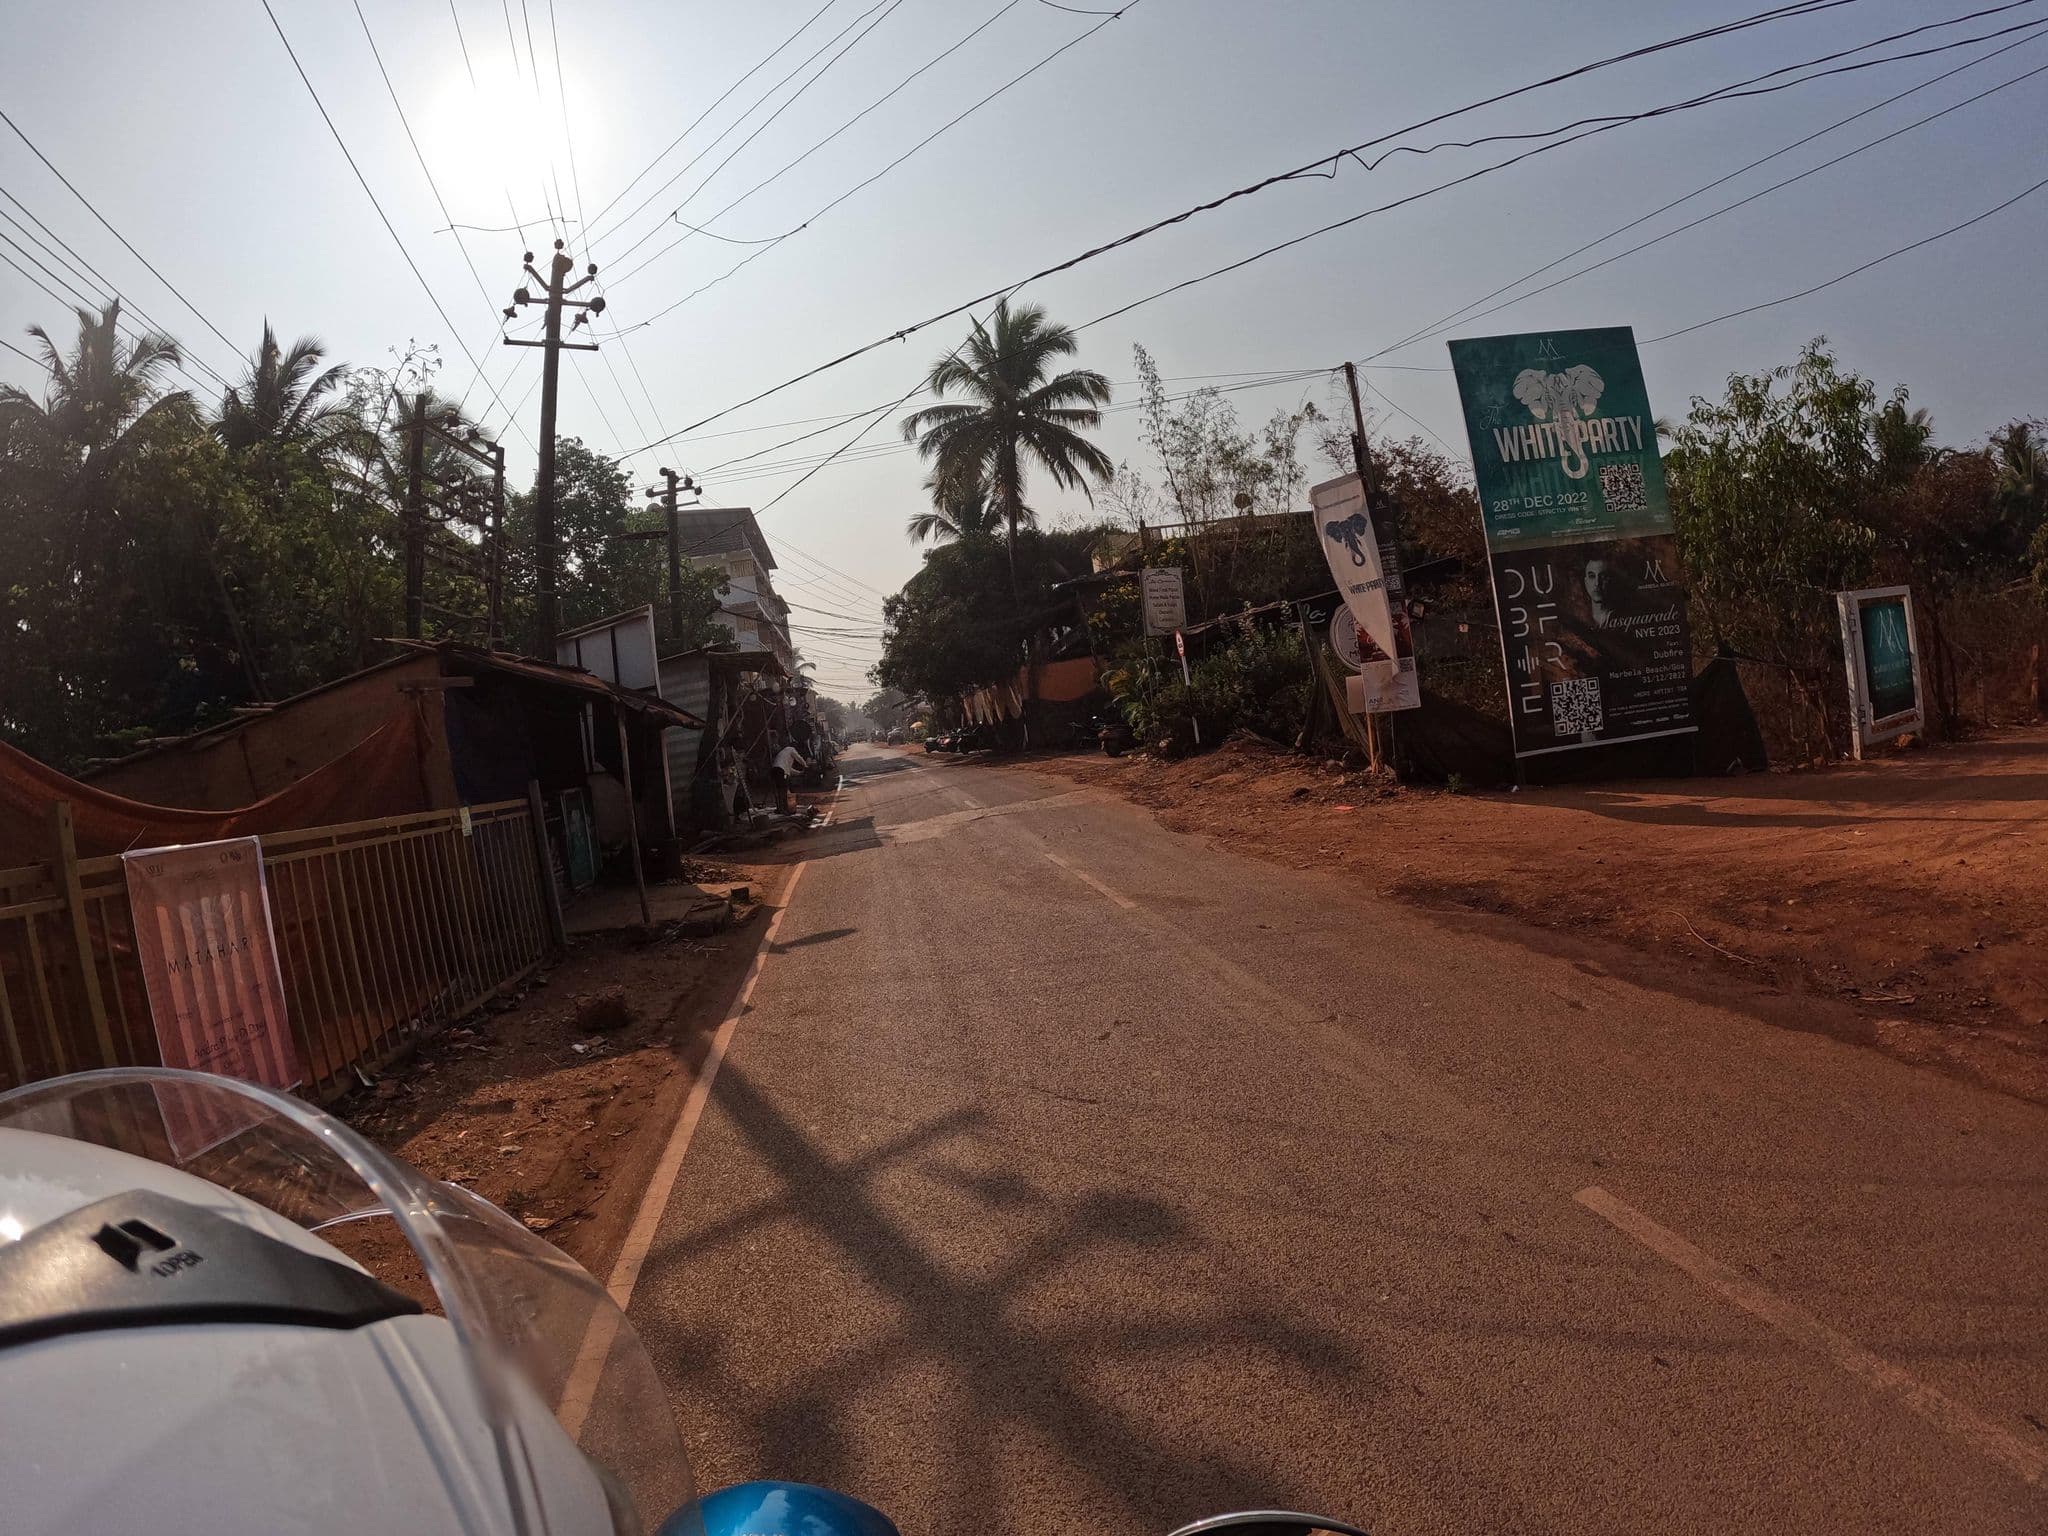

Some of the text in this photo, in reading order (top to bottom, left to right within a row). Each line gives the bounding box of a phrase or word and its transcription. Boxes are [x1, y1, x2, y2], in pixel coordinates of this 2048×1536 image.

[1493, 416, 1644, 463] WHITE PARTY
[1493, 491, 1588, 513] 28TH DEC 2022
[1635, 624, 1681, 639] NYE 2023
[1653, 648, 1684, 660] Dubfire
[1609, 669, 1642, 680] Marbela
[167, 935, 254, 976] MATAHARI
